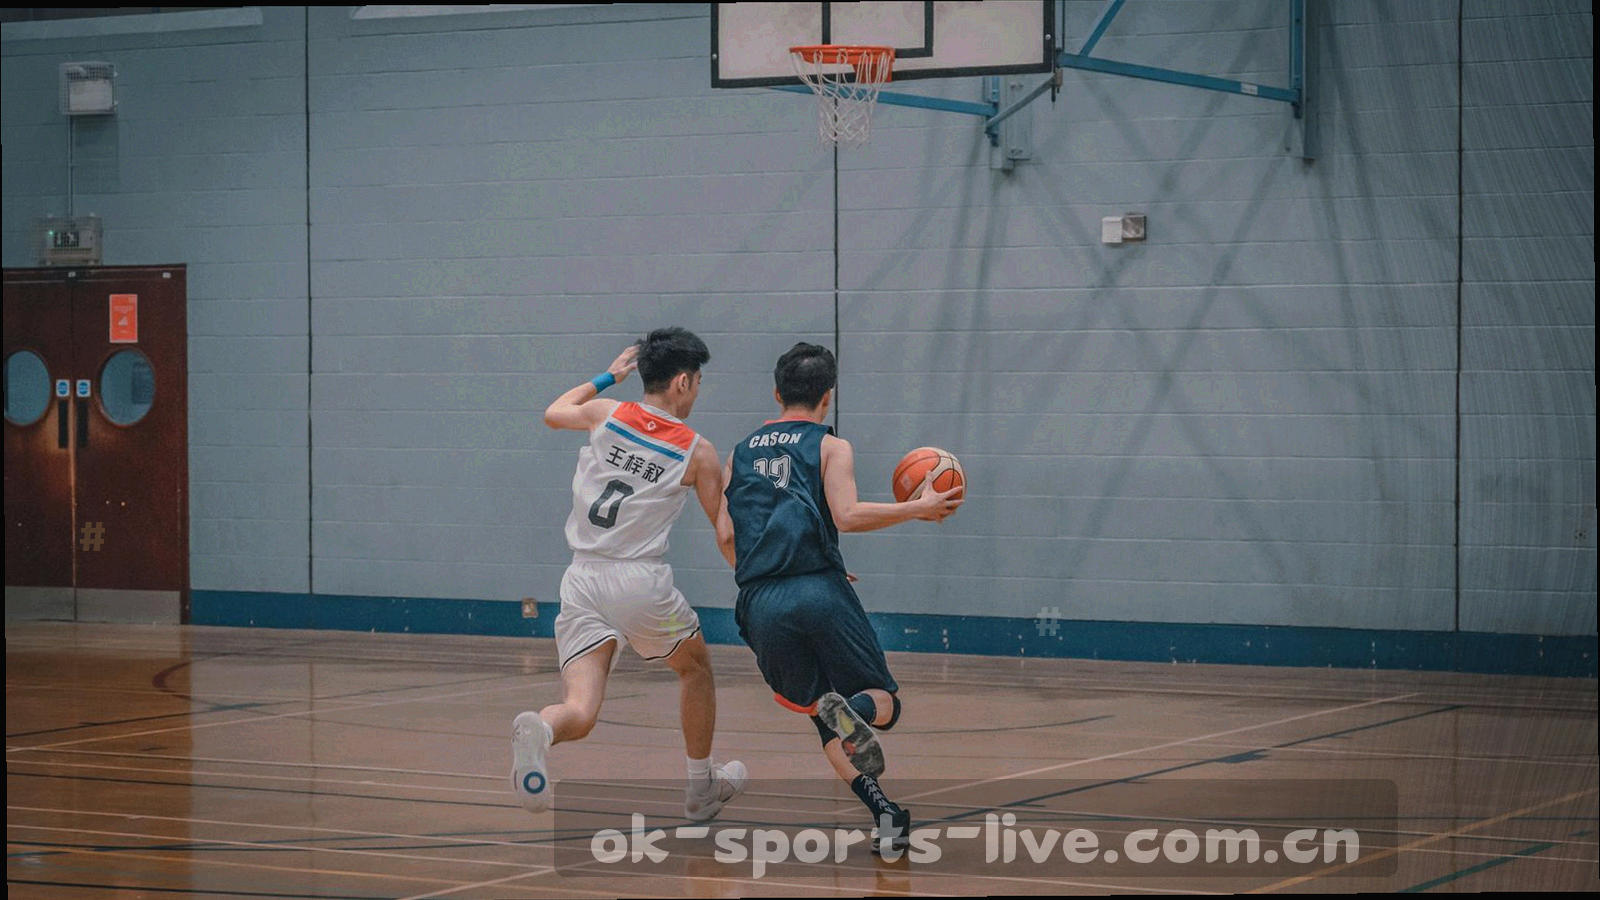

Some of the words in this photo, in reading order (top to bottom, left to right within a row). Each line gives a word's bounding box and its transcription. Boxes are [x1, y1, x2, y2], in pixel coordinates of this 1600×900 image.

[749, 431, 802, 448] CASON
[606, 445, 665, 483] 王梓叙
[588, 479, 634, 529] 0
